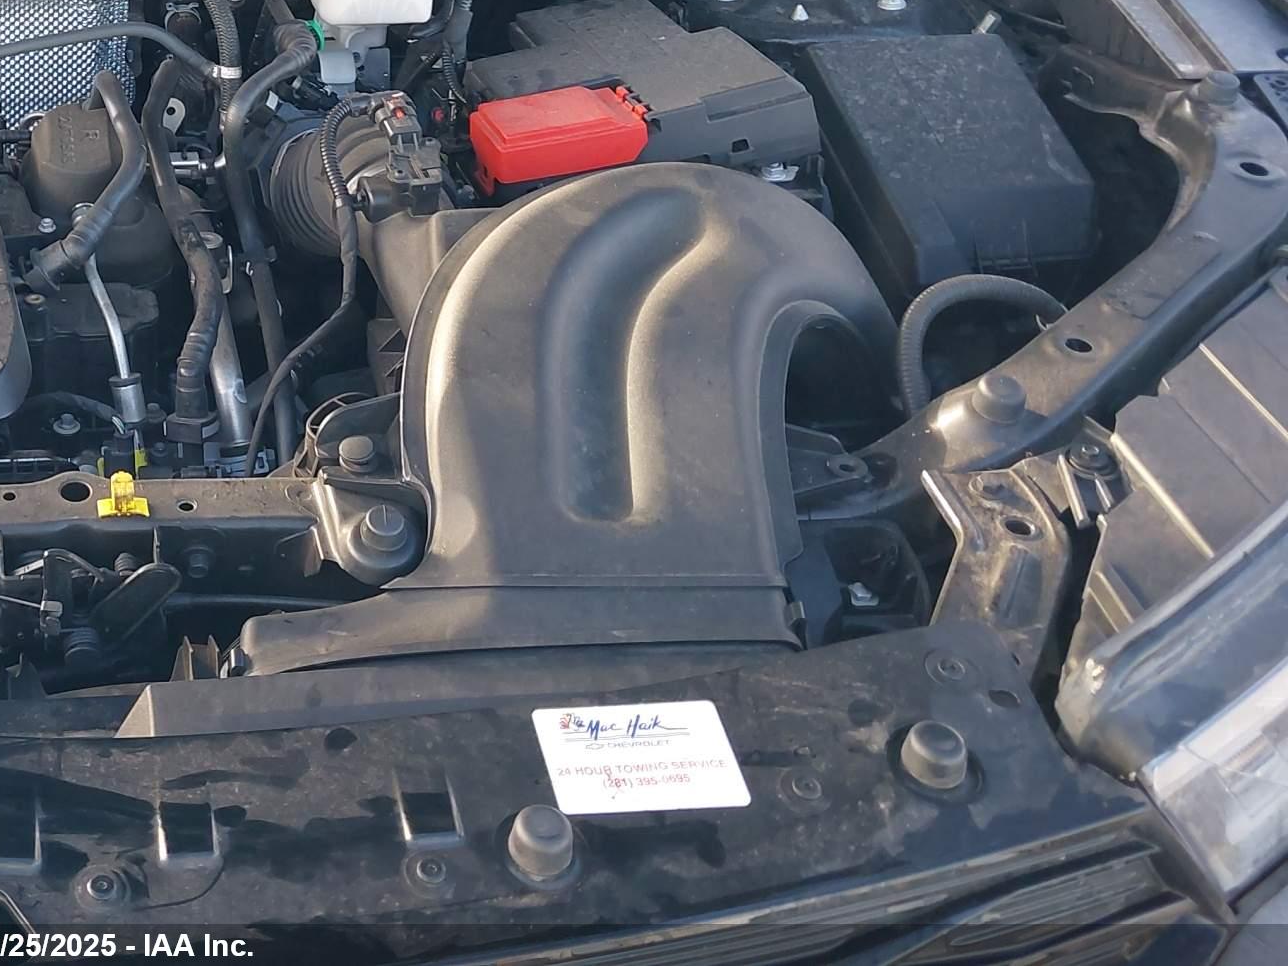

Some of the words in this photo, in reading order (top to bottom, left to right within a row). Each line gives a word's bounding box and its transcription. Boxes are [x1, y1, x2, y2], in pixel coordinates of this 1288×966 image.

[586, 720, 622, 740] Mac
[627, 714, 677, 738] Haik
[608, 740, 670, 748] CHEVROLET
[558, 767, 571, 776] 24
[576, 765, 612, 776] HOUR
[615, 762, 669, 774] TOWING
[671, 759, 728, 770] SERVICE
[603, 777, 634, 789] (281)
